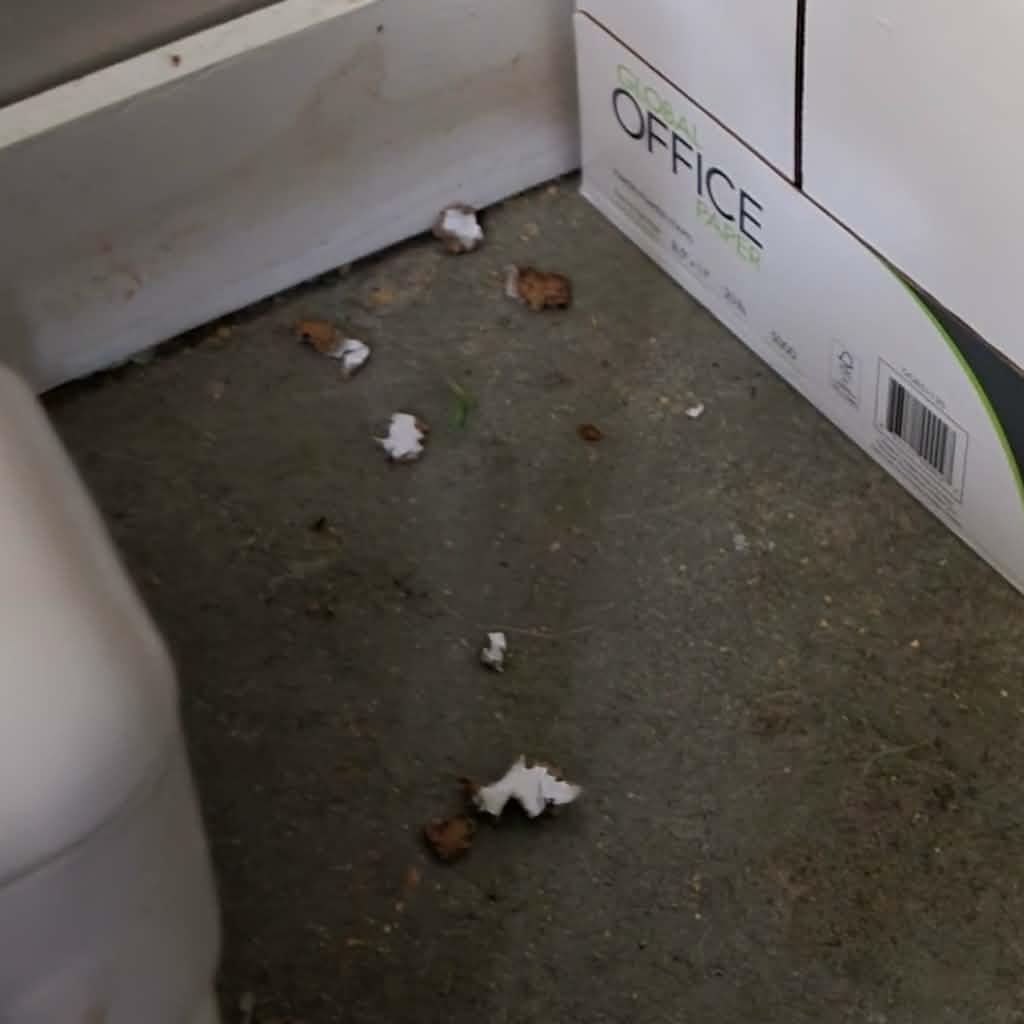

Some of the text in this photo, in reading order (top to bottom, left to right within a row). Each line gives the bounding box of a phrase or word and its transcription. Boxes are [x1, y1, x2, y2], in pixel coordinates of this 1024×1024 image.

[616, 63, 700, 149] GLOBAL
[612, 87, 764, 250] OFFICE
[696, 198, 761, 270] PAPER
